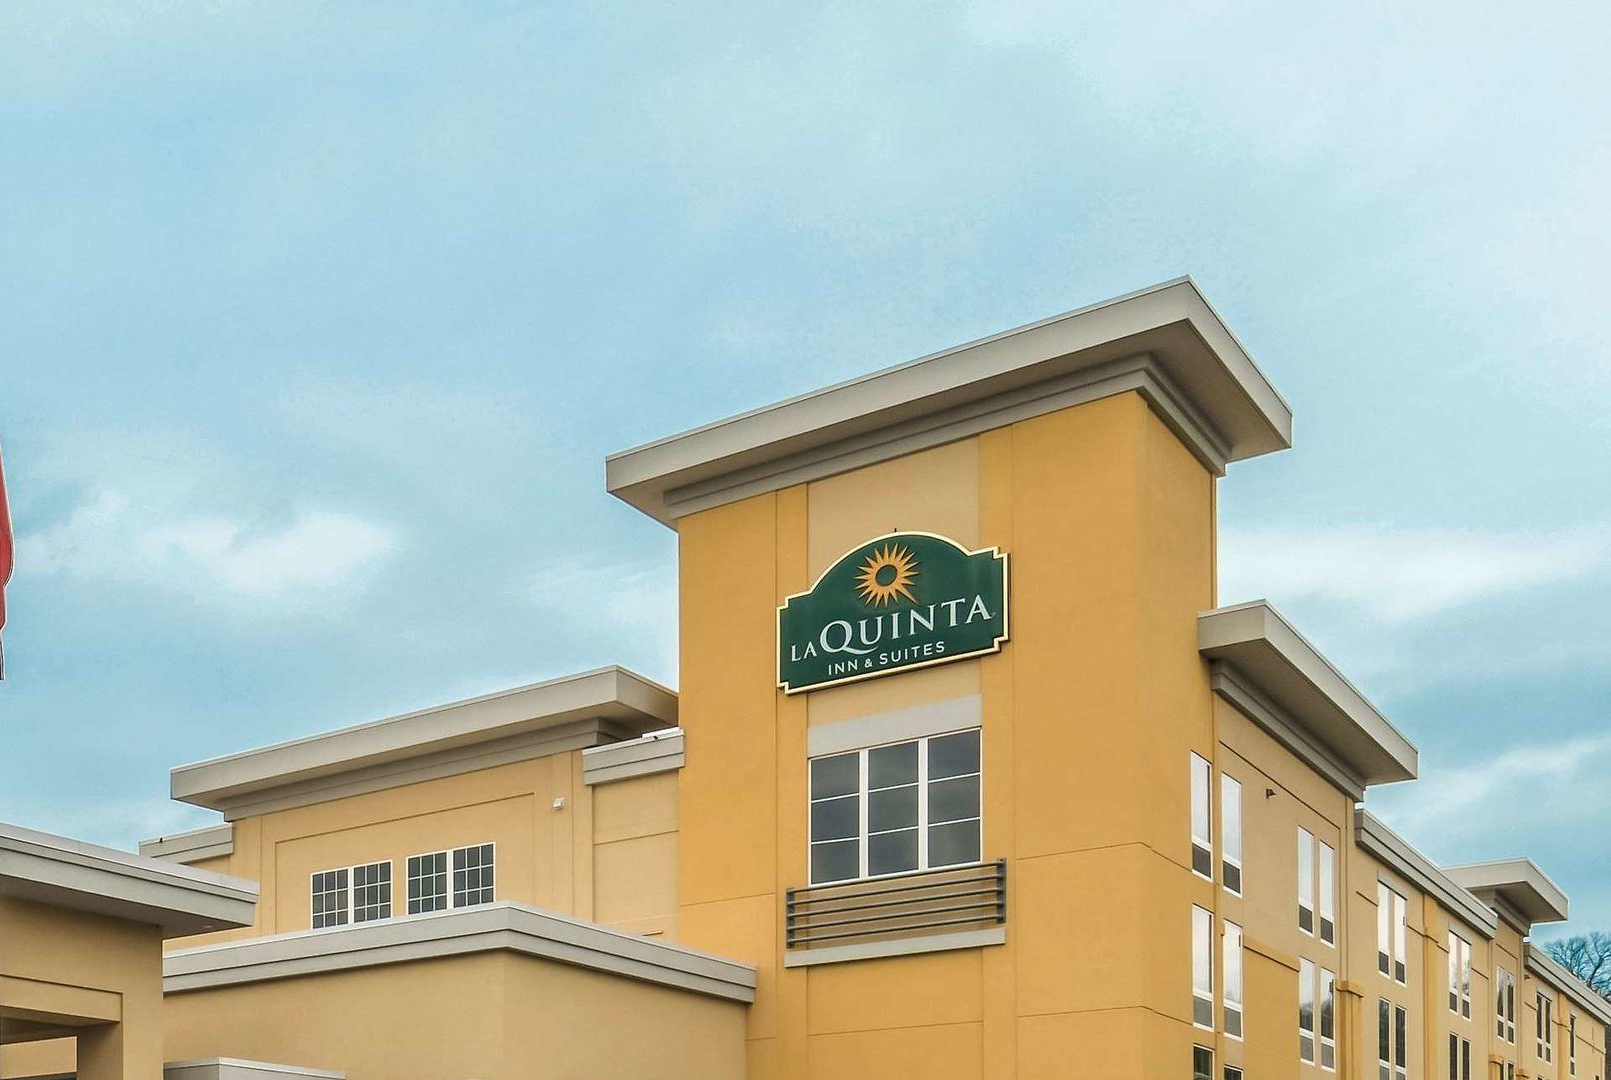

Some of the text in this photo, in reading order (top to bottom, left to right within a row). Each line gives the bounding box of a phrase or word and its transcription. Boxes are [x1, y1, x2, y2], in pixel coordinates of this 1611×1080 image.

[791, 594, 991, 662] LA QUINTA
[828, 641, 946, 676] INN & SUITES
